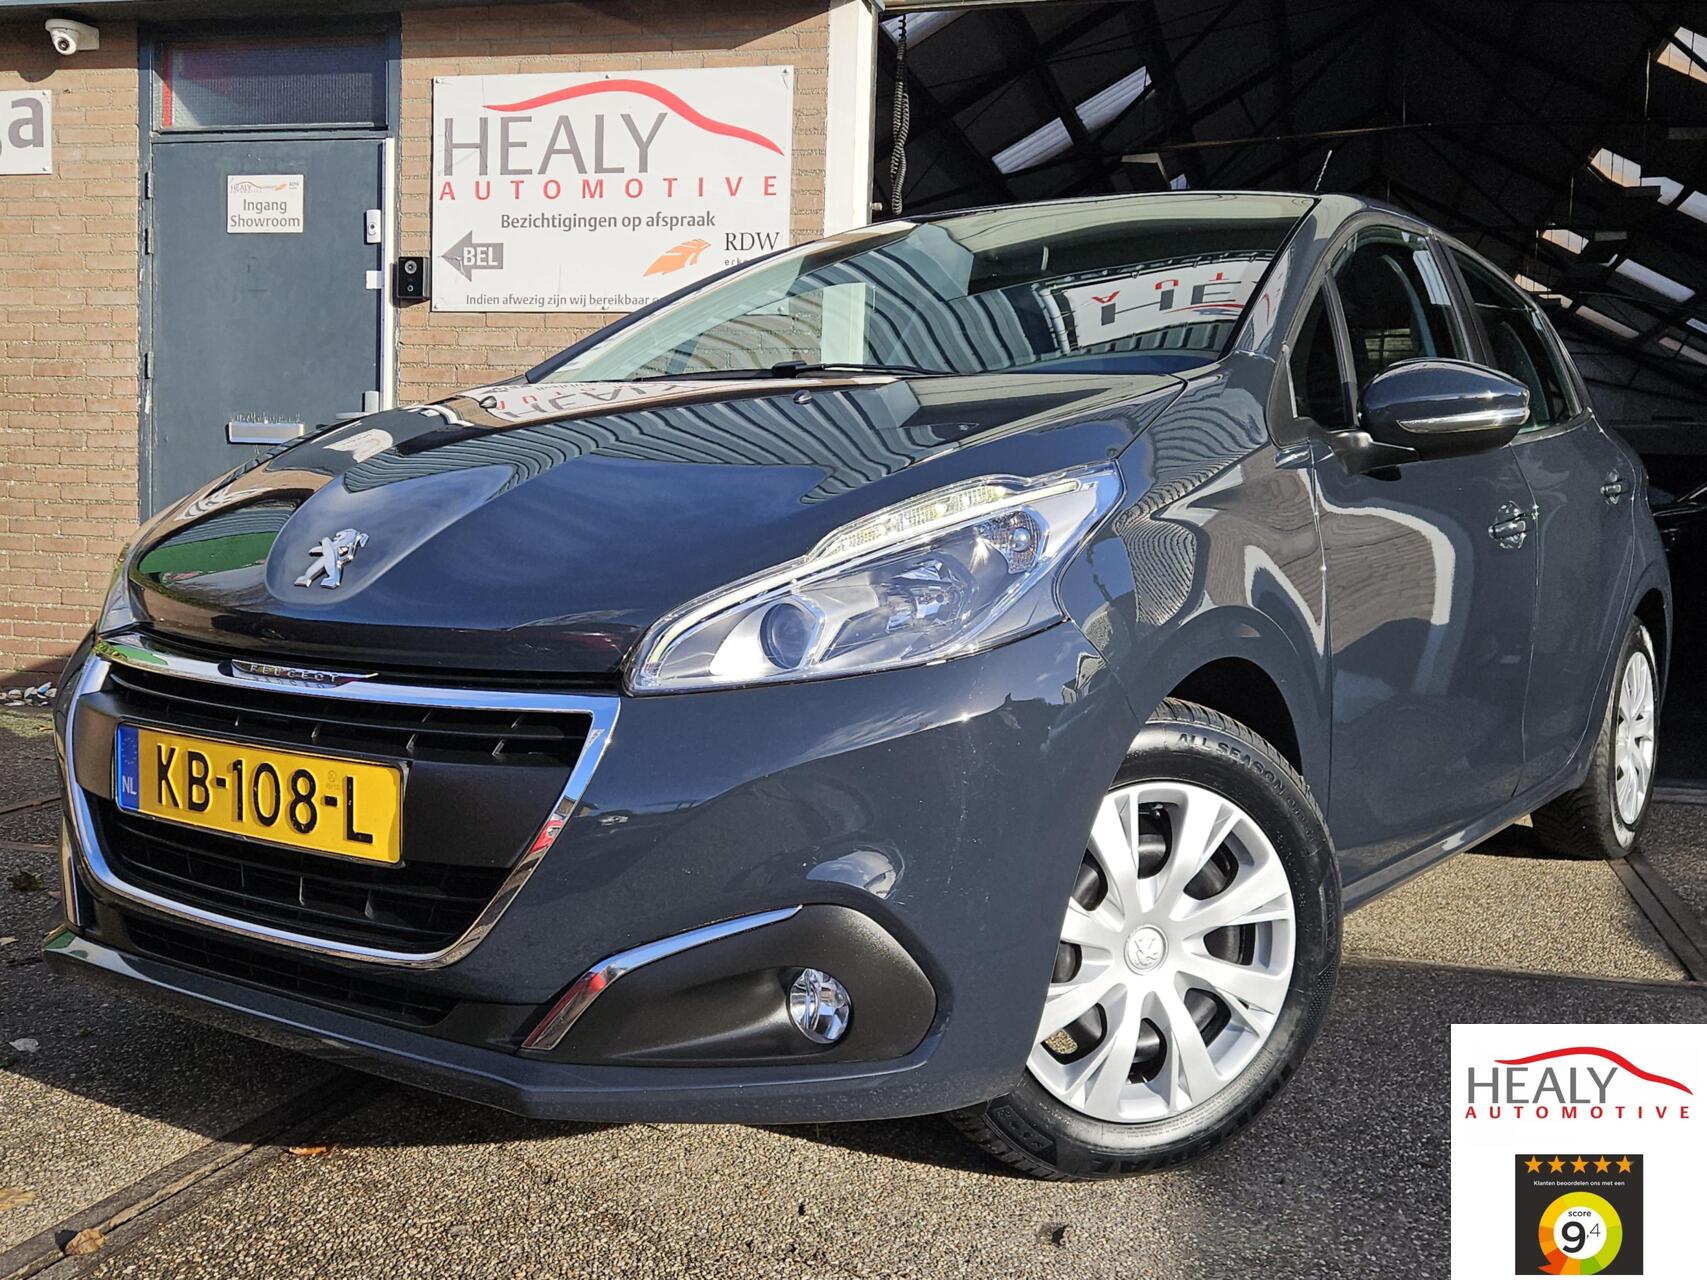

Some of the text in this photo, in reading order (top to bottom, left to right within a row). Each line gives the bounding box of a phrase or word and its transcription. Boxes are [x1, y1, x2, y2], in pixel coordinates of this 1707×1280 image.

[444, 113, 668, 176] HEALY
[439, 176, 777, 200] AUTOMOTIVE
[243, 199, 287, 214] Ingang
[230, 214, 300, 227] Showroom
[501, 211, 716, 232] Bezichtigingen op afspraak
[724, 232, 780, 251] RDW
[463, 247, 498, 266] BEL
[466, 293, 649, 307] Indien afwezig zijn wij bereikbaar
[250, 664, 338, 682] PEUGEOT
[1178, 733, 1286, 796] ALL SEASON
[122, 775, 137, 795] NL
[157, 744, 373, 843] KB-108-L
